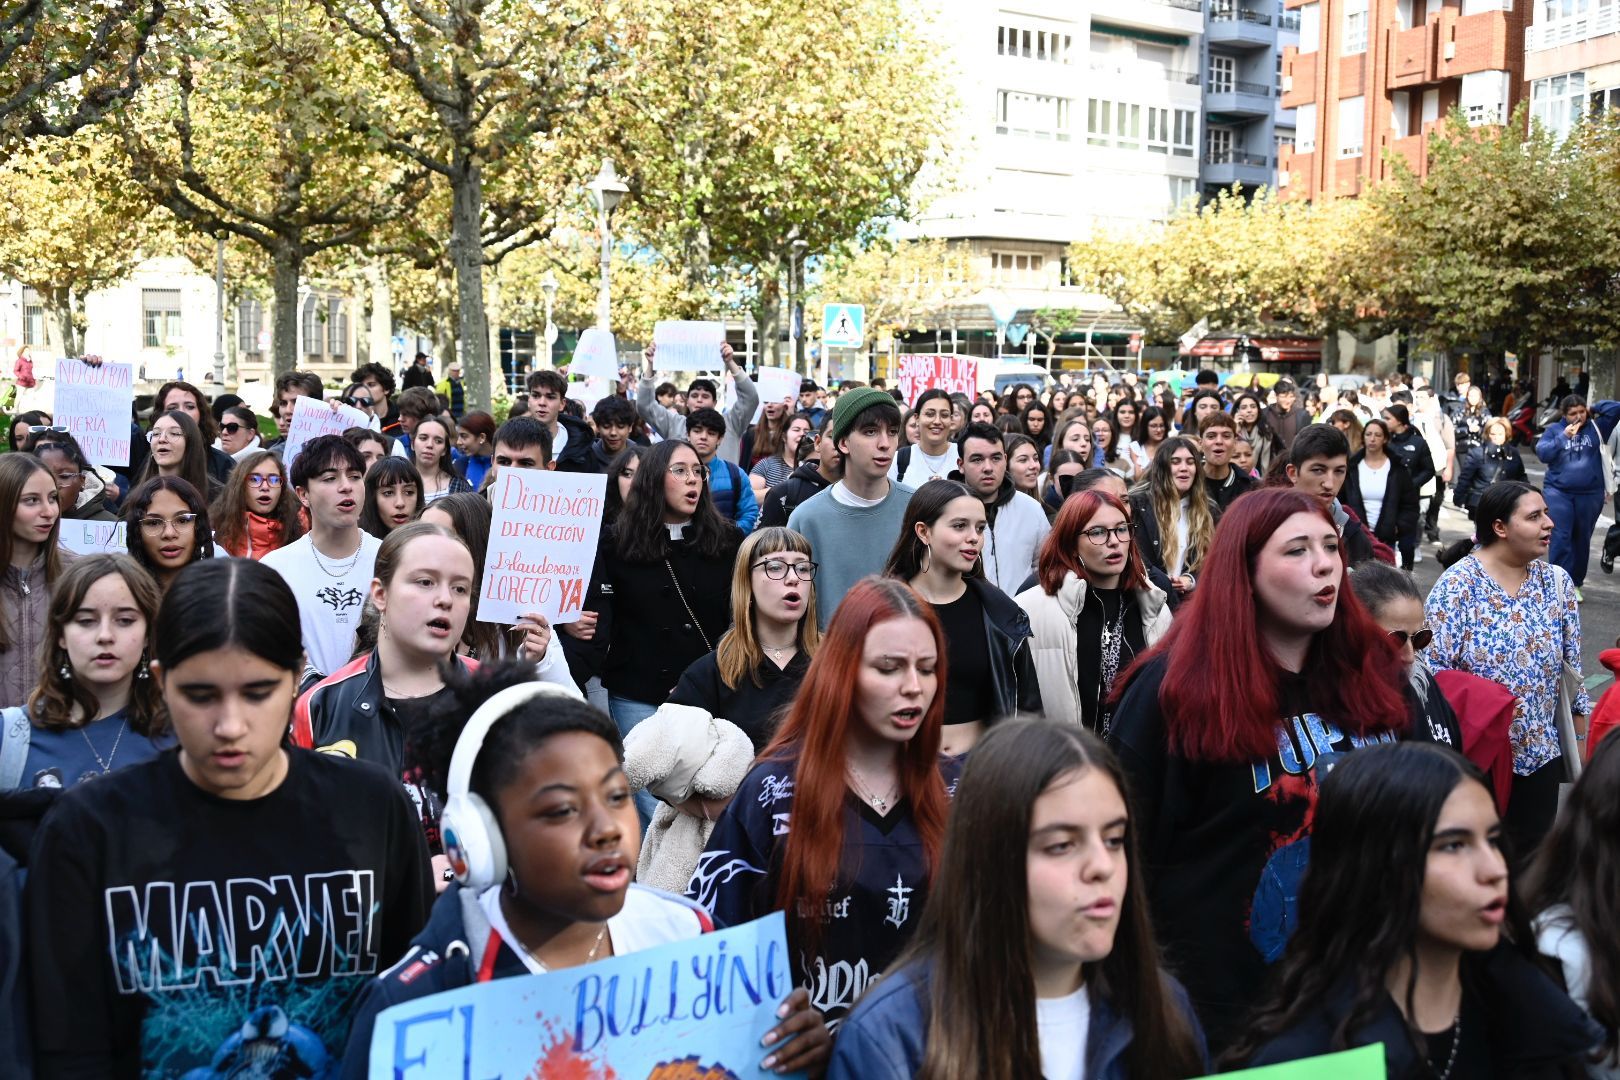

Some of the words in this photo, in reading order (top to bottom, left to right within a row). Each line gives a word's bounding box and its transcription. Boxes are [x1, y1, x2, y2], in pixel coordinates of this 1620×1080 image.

[898, 355, 936, 378] SANDRA
[940, 357, 953, 378] TU
[898, 377, 912, 398] NO
[501, 474, 600, 518] Dimisión
[486, 574, 552, 605] LORETO
[558, 578, 583, 618] YA
[104, 869, 380, 995] MARVEL
